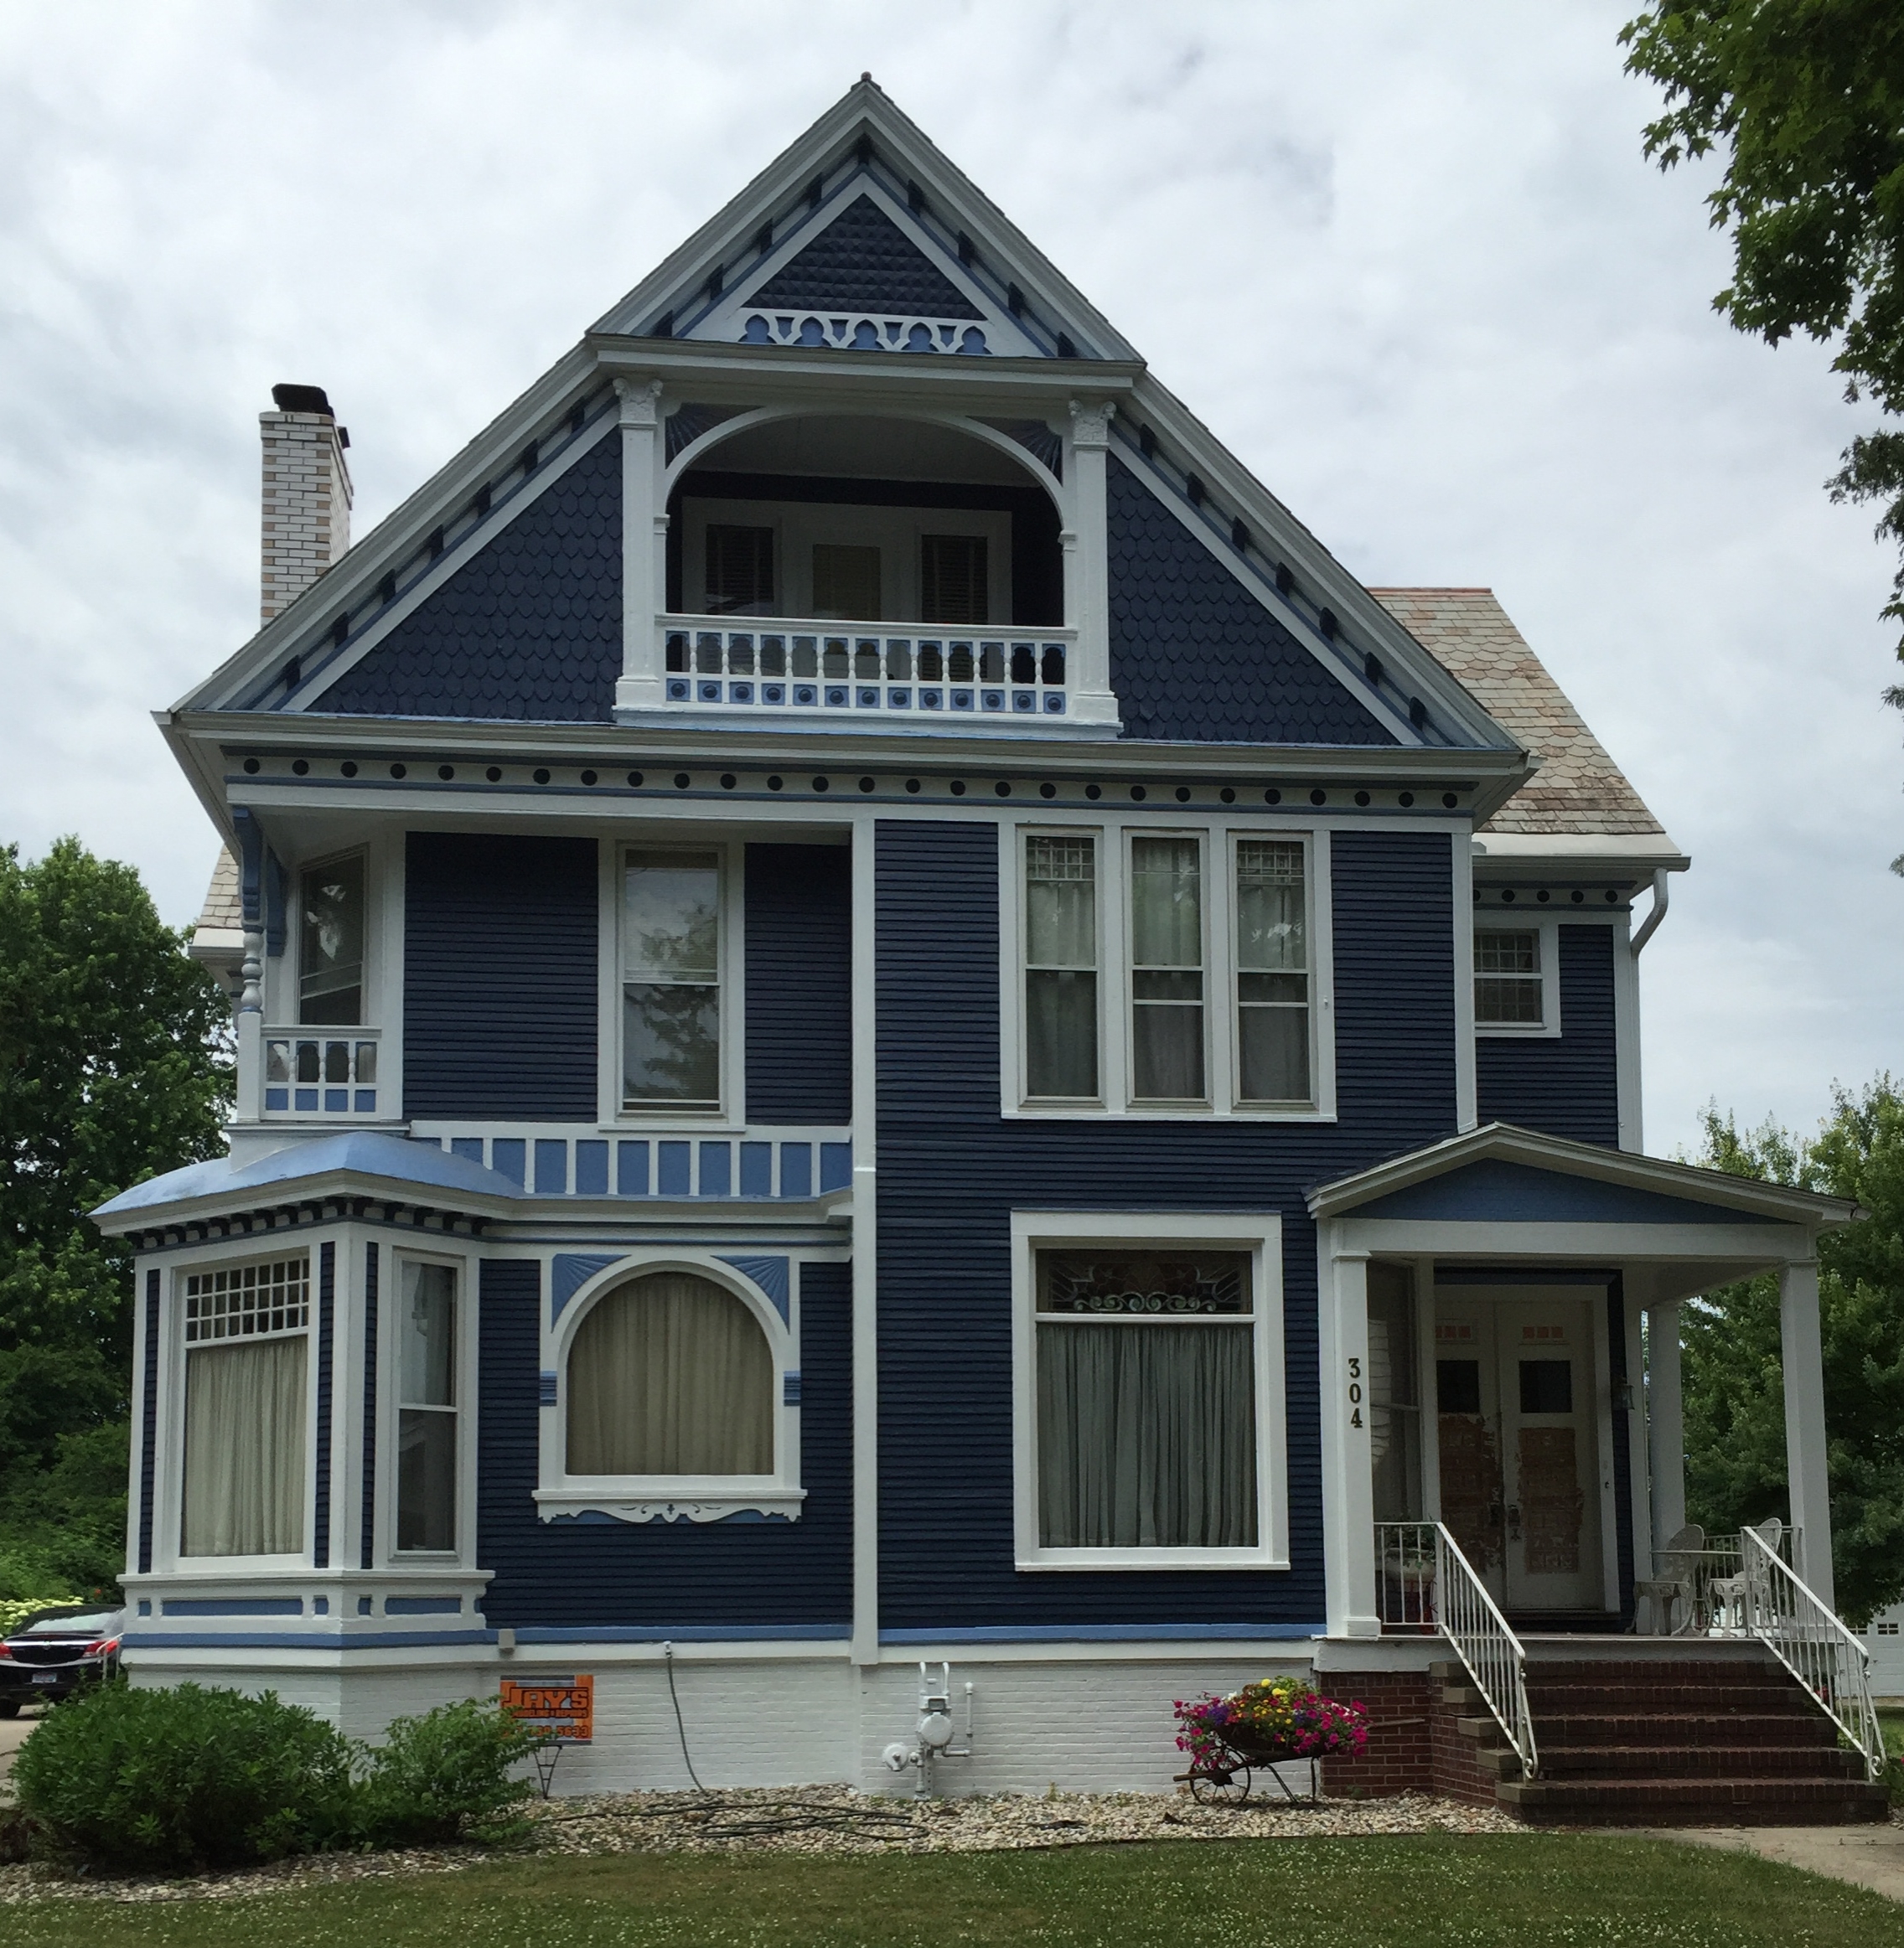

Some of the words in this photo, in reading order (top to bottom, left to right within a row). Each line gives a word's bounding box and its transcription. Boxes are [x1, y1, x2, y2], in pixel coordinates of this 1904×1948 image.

[1348, 1357, 1363, 1429] 304
[503, 1687, 588, 1709] JAY'S
[556, 1725, 588, 1737] 5633
